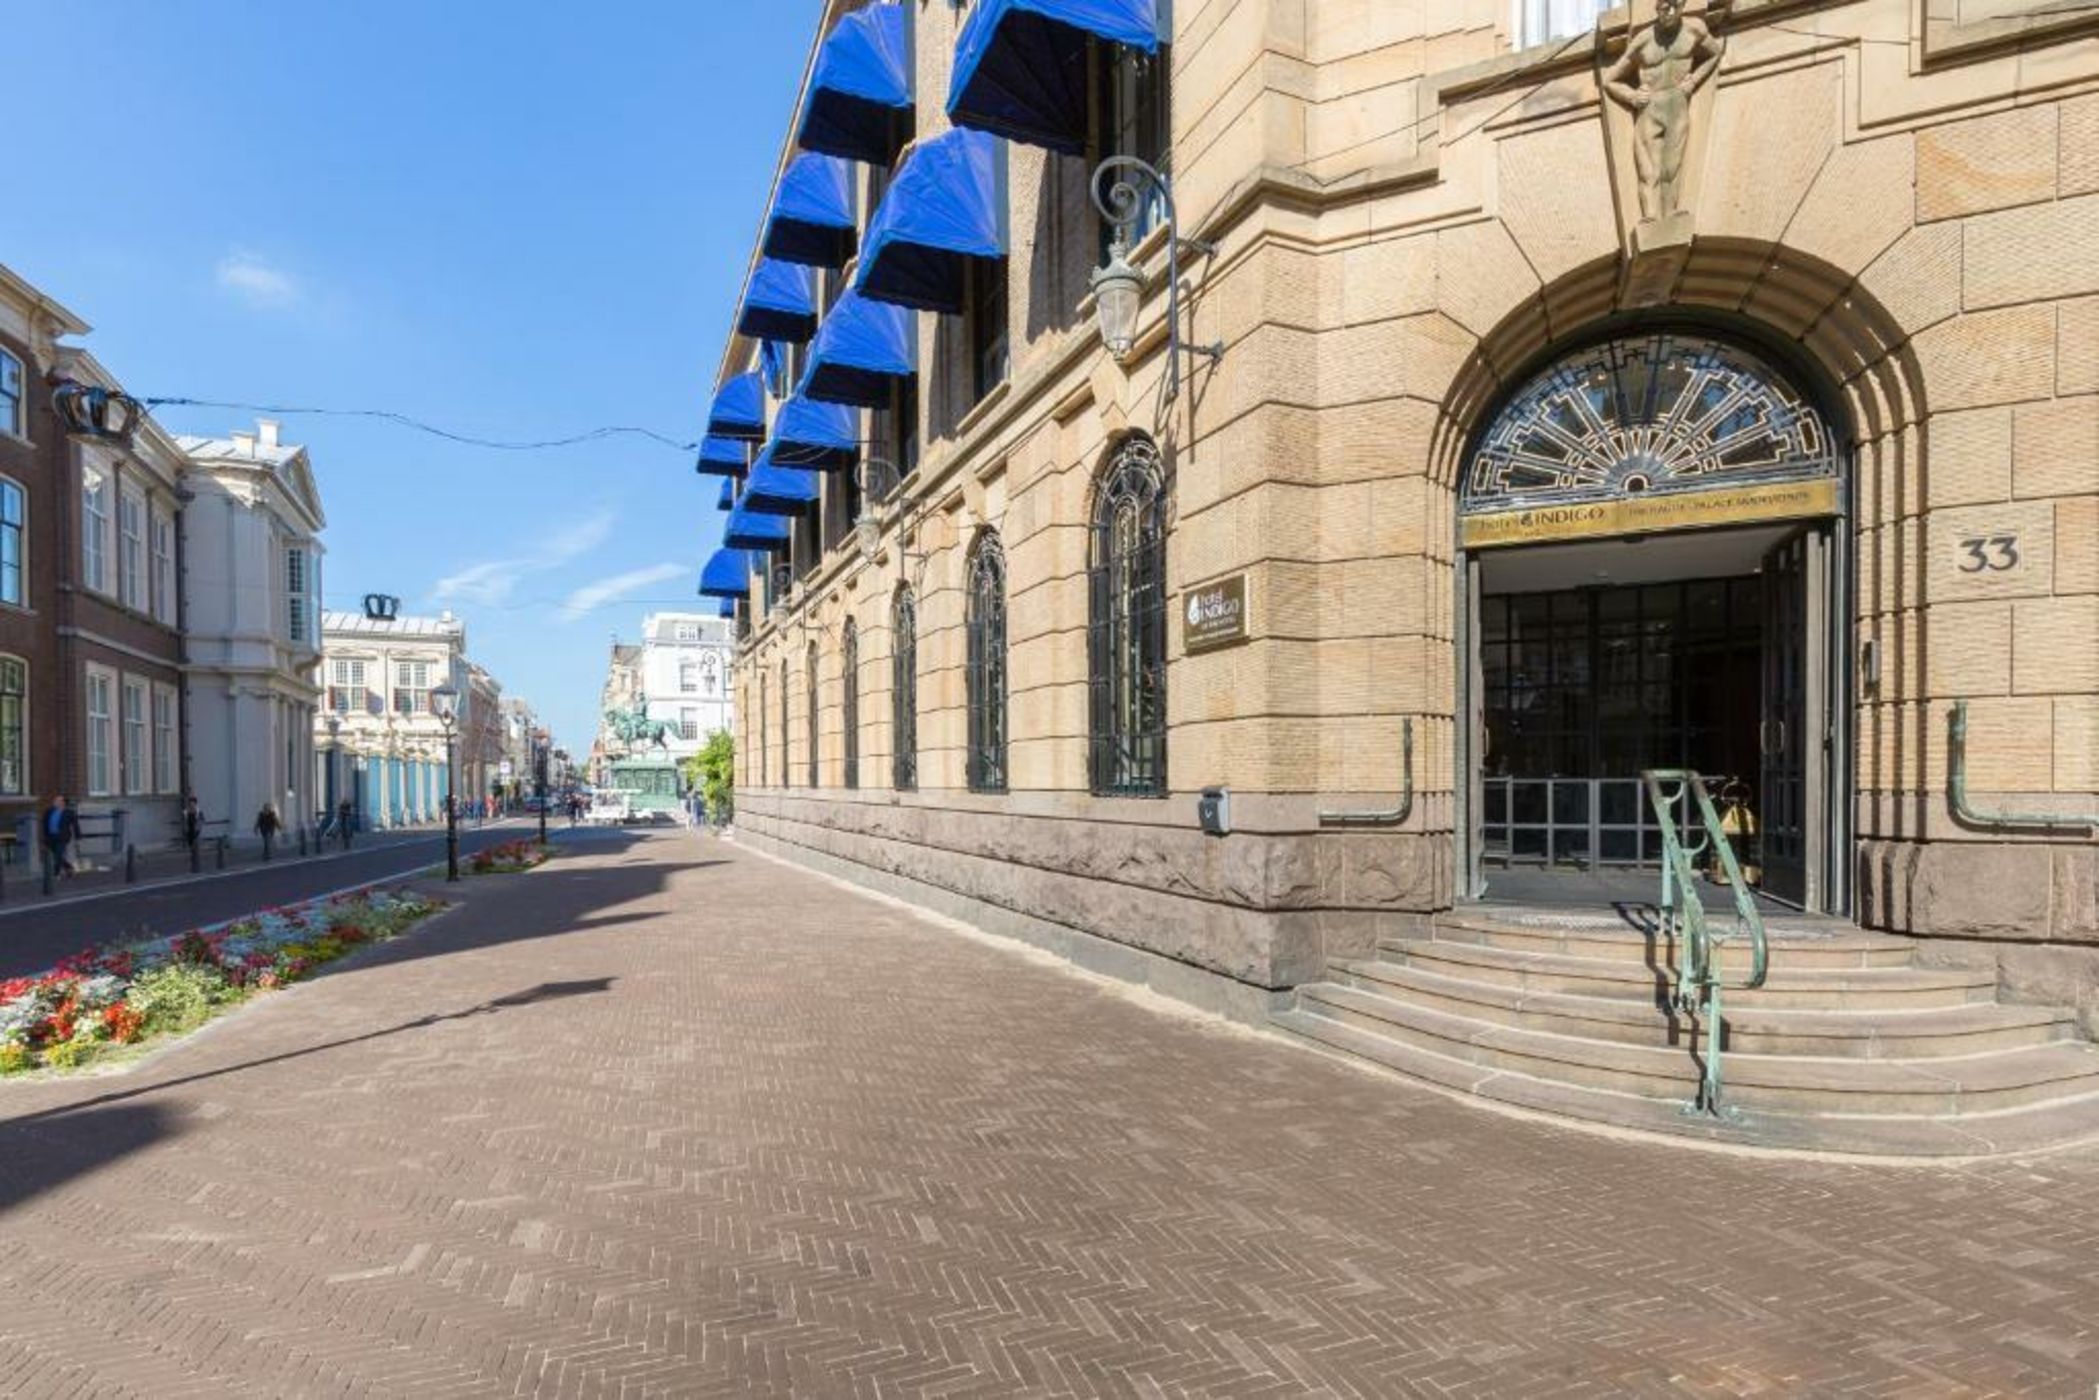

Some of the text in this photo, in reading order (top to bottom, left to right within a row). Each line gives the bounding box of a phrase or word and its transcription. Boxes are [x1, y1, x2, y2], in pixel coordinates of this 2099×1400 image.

[1535, 507, 1604, 525] INDIGO
[1958, 536, 2018, 573] 33
[1201, 598, 1239, 620] INDIGO
